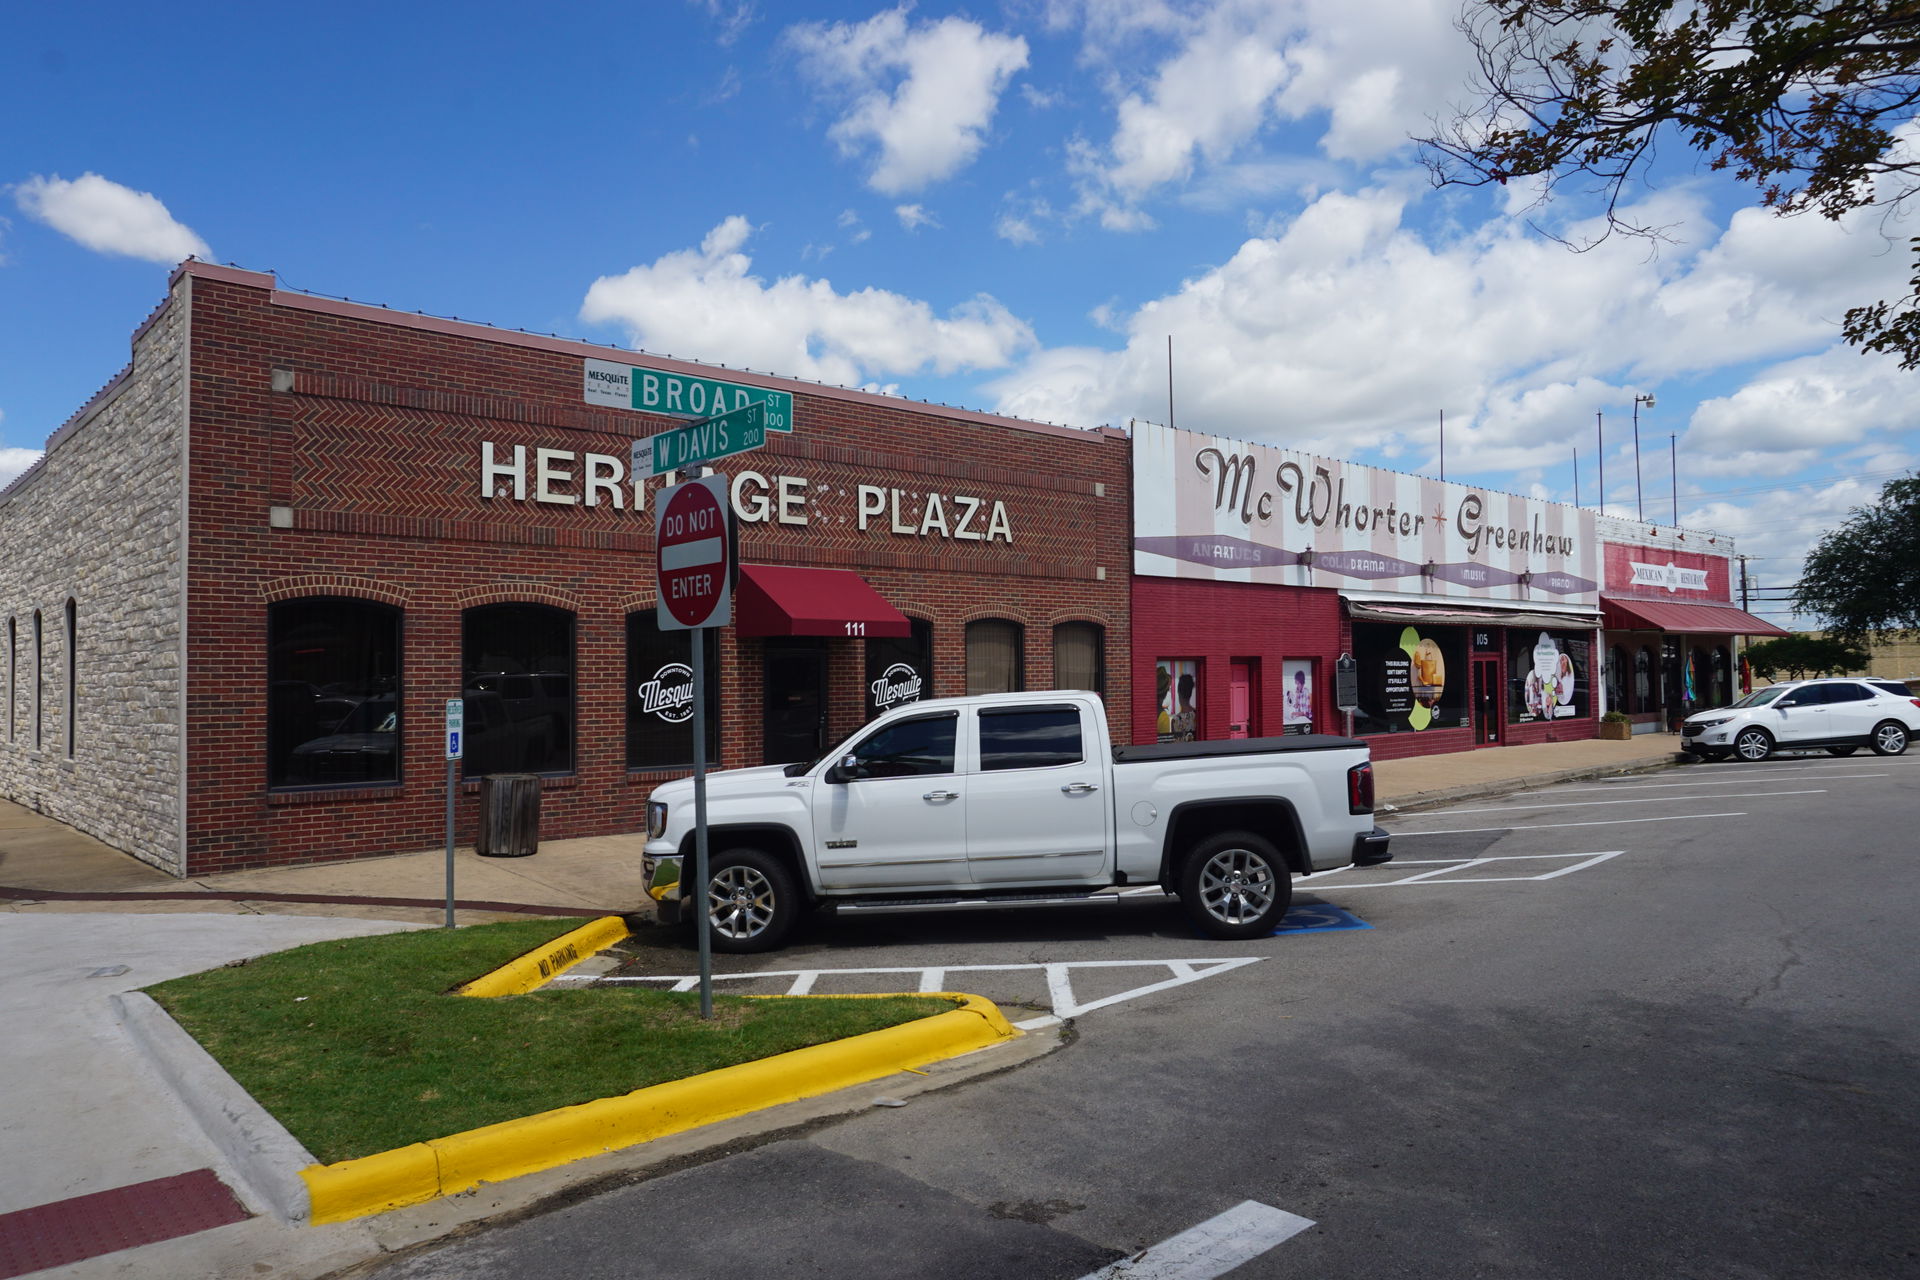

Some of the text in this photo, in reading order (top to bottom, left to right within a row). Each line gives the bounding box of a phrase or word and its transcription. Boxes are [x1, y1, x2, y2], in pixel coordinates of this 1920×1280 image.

[643, 374, 750, 415] BROAD
[767, 394, 780, 407] ST
[747, 408, 757, 424] ST
[659, 420, 728, 467] W DAVIS
[743, 428, 759, 446] 200
[482, 441, 1013, 543] HERIGE PLAZA
[666, 507, 715, 537] DO NOT
[1457, 494, 1573, 555] Greenhaw
[1350, 559, 1385, 572] DRAMA
[1463, 570, 1485, 580] MUSIC
[1636, 568, 1662, 581] MEXICAN
[672, 574, 711, 599] ENTER
[845, 622, 864, 636] 111
[1477, 633, 1488, 645] 105
[660, 667, 691, 679] DOWNTOWN
[639, 679, 693, 712] Mesqui
[872, 675, 922, 706] Mesquite
[538, 943, 578, 979] NO PARKING
